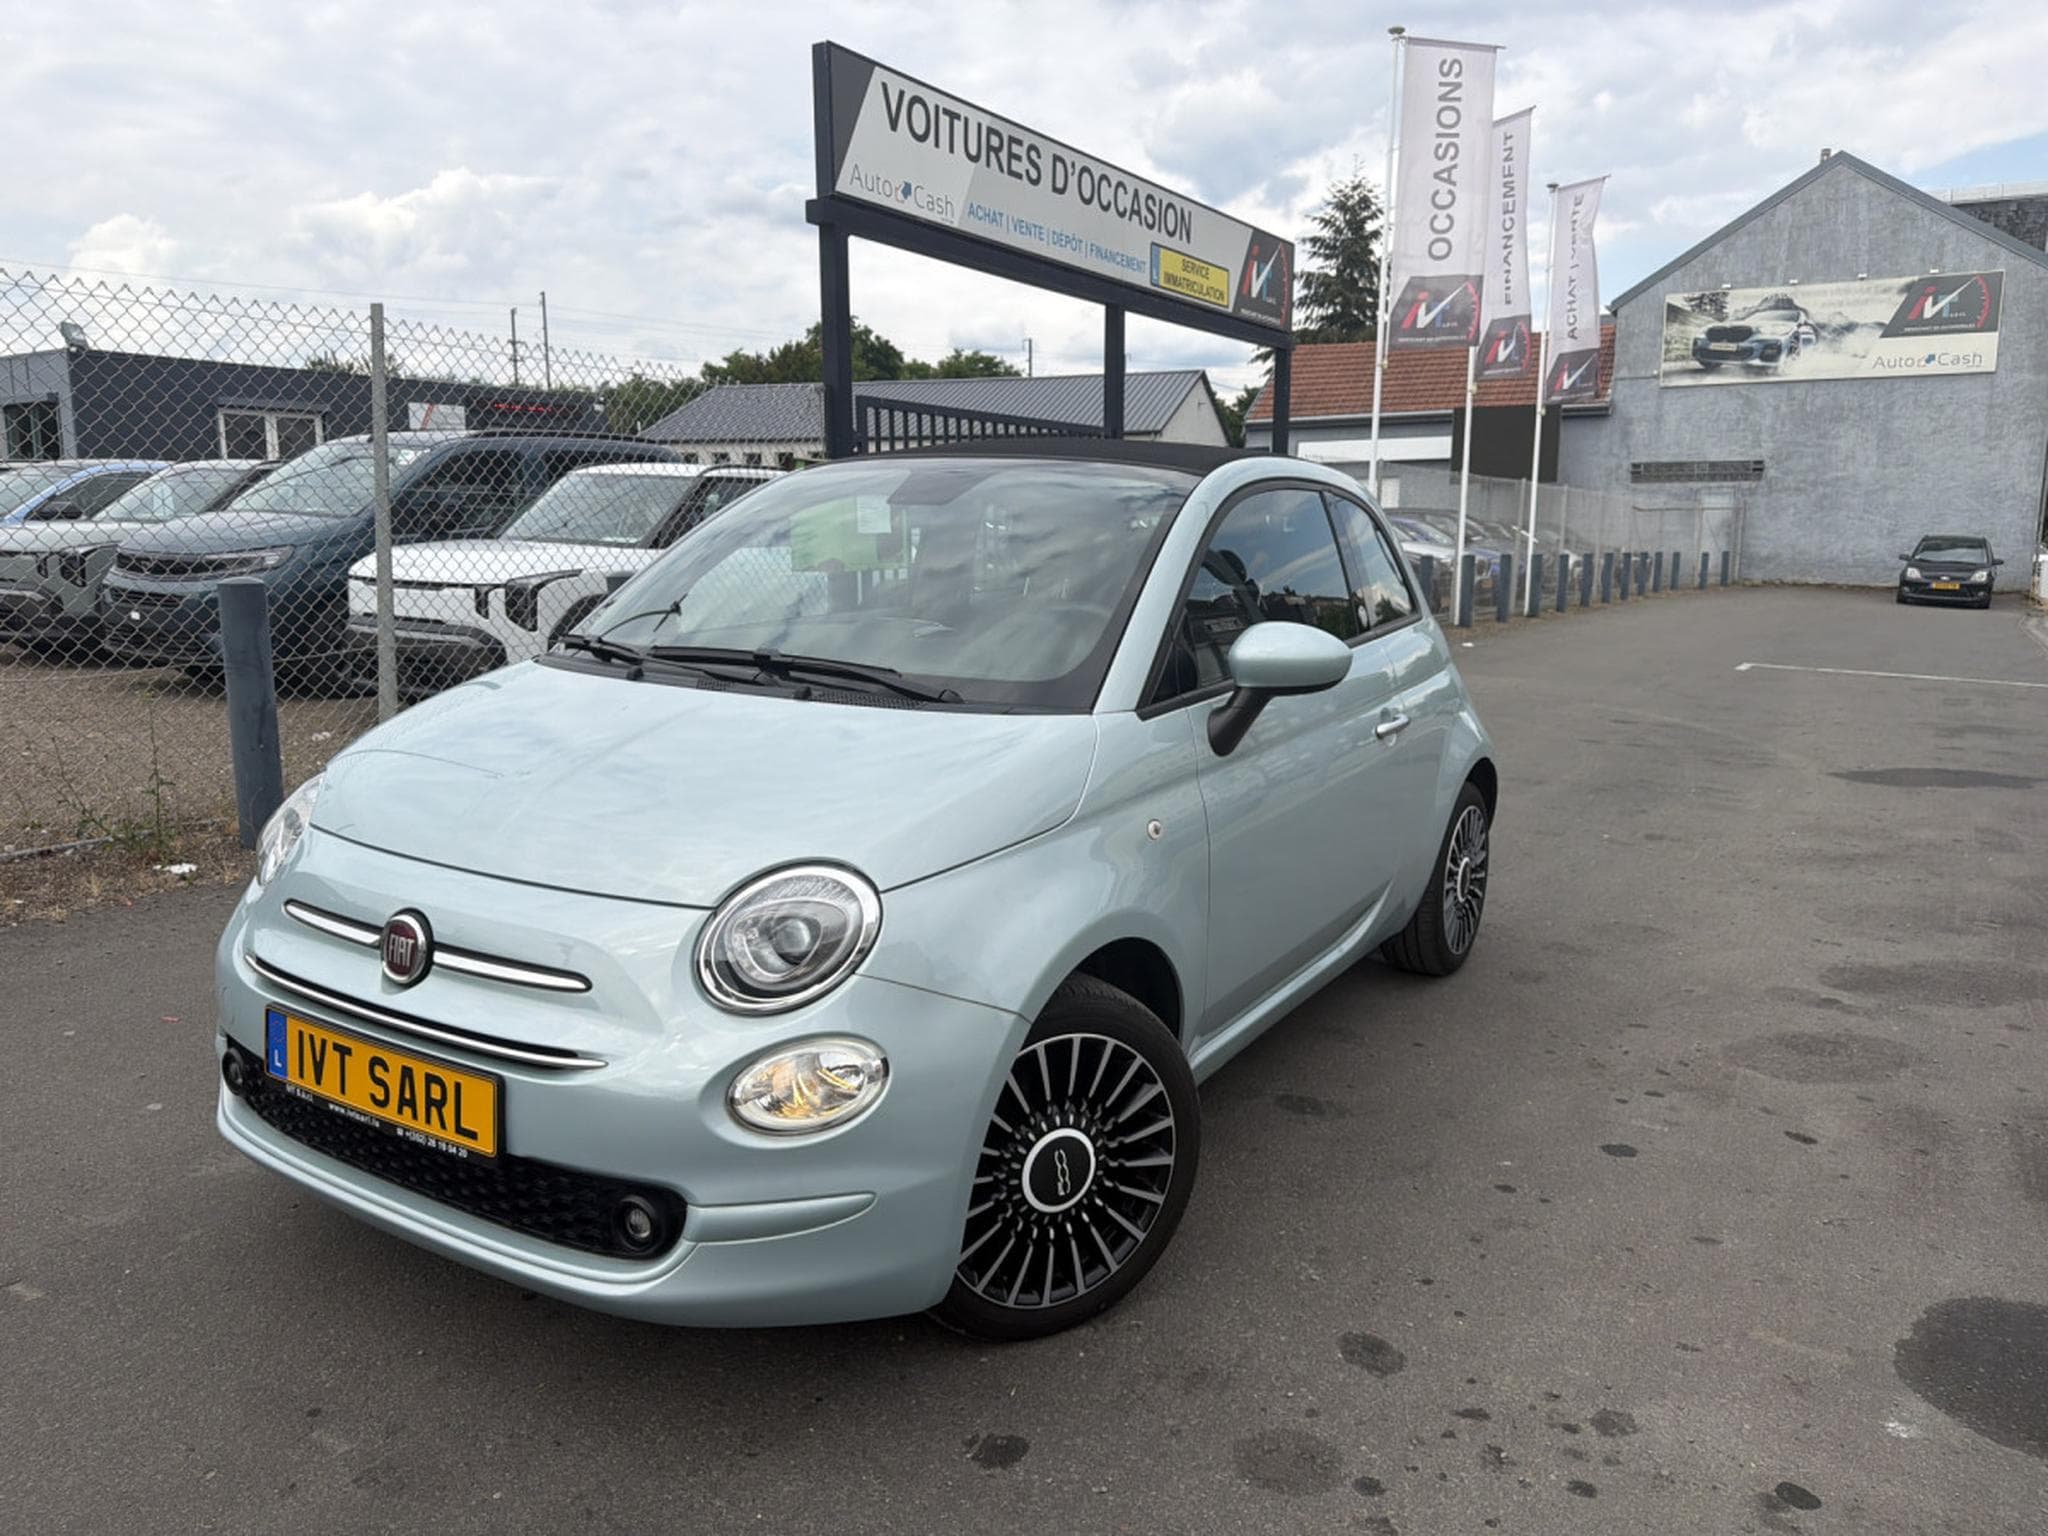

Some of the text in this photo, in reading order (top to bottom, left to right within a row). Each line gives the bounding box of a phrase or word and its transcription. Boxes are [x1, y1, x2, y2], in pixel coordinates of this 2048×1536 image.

[881, 81, 1192, 244] VOITURES D'OCCASION
[1427, 58, 1463, 261] OCCASIONS
[967, 202, 1147, 274] ACHAT VENTE DÉPÔT FINANCEMENT
[1182, 258, 1211, 281] SERVICE
[1163, 270, 1225, 302] IMMATRICULATION
[1566, 275, 1579, 341] ACHAT
[388, 932, 416, 968] FIAT
[274, 1049, 282, 1068] L
[298, 1029, 478, 1142] IVT SARL
